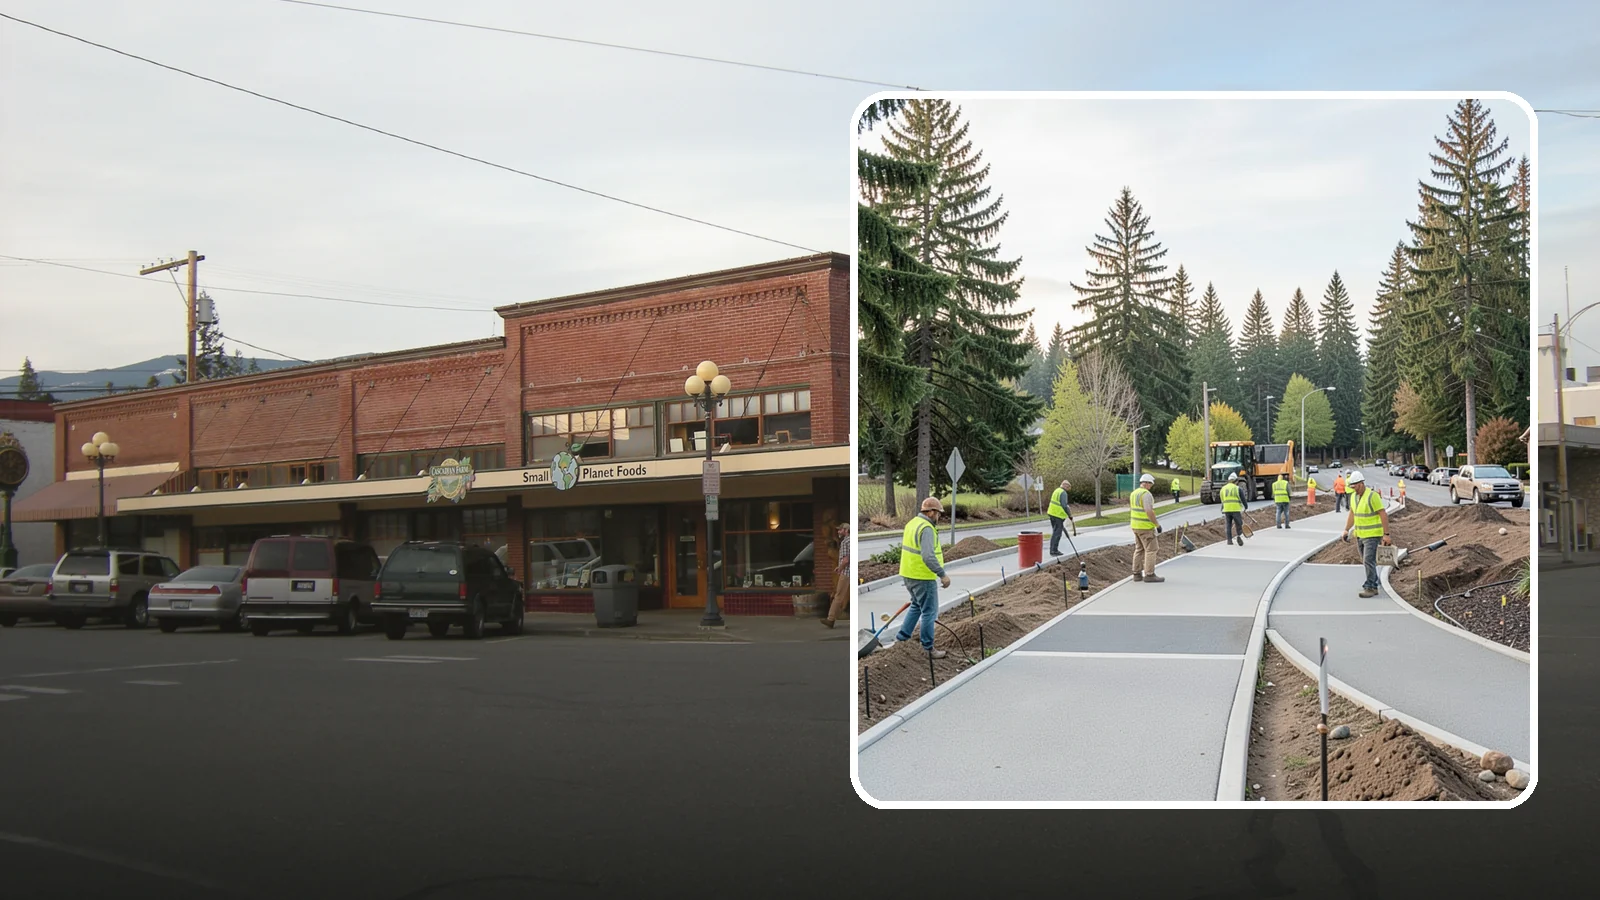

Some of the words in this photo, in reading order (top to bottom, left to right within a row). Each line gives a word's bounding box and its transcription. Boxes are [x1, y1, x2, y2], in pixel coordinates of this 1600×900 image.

[523, 471, 549, 482] Small
[583, 468, 614, 479] Planet
[617, 464, 647, 476] Foods
